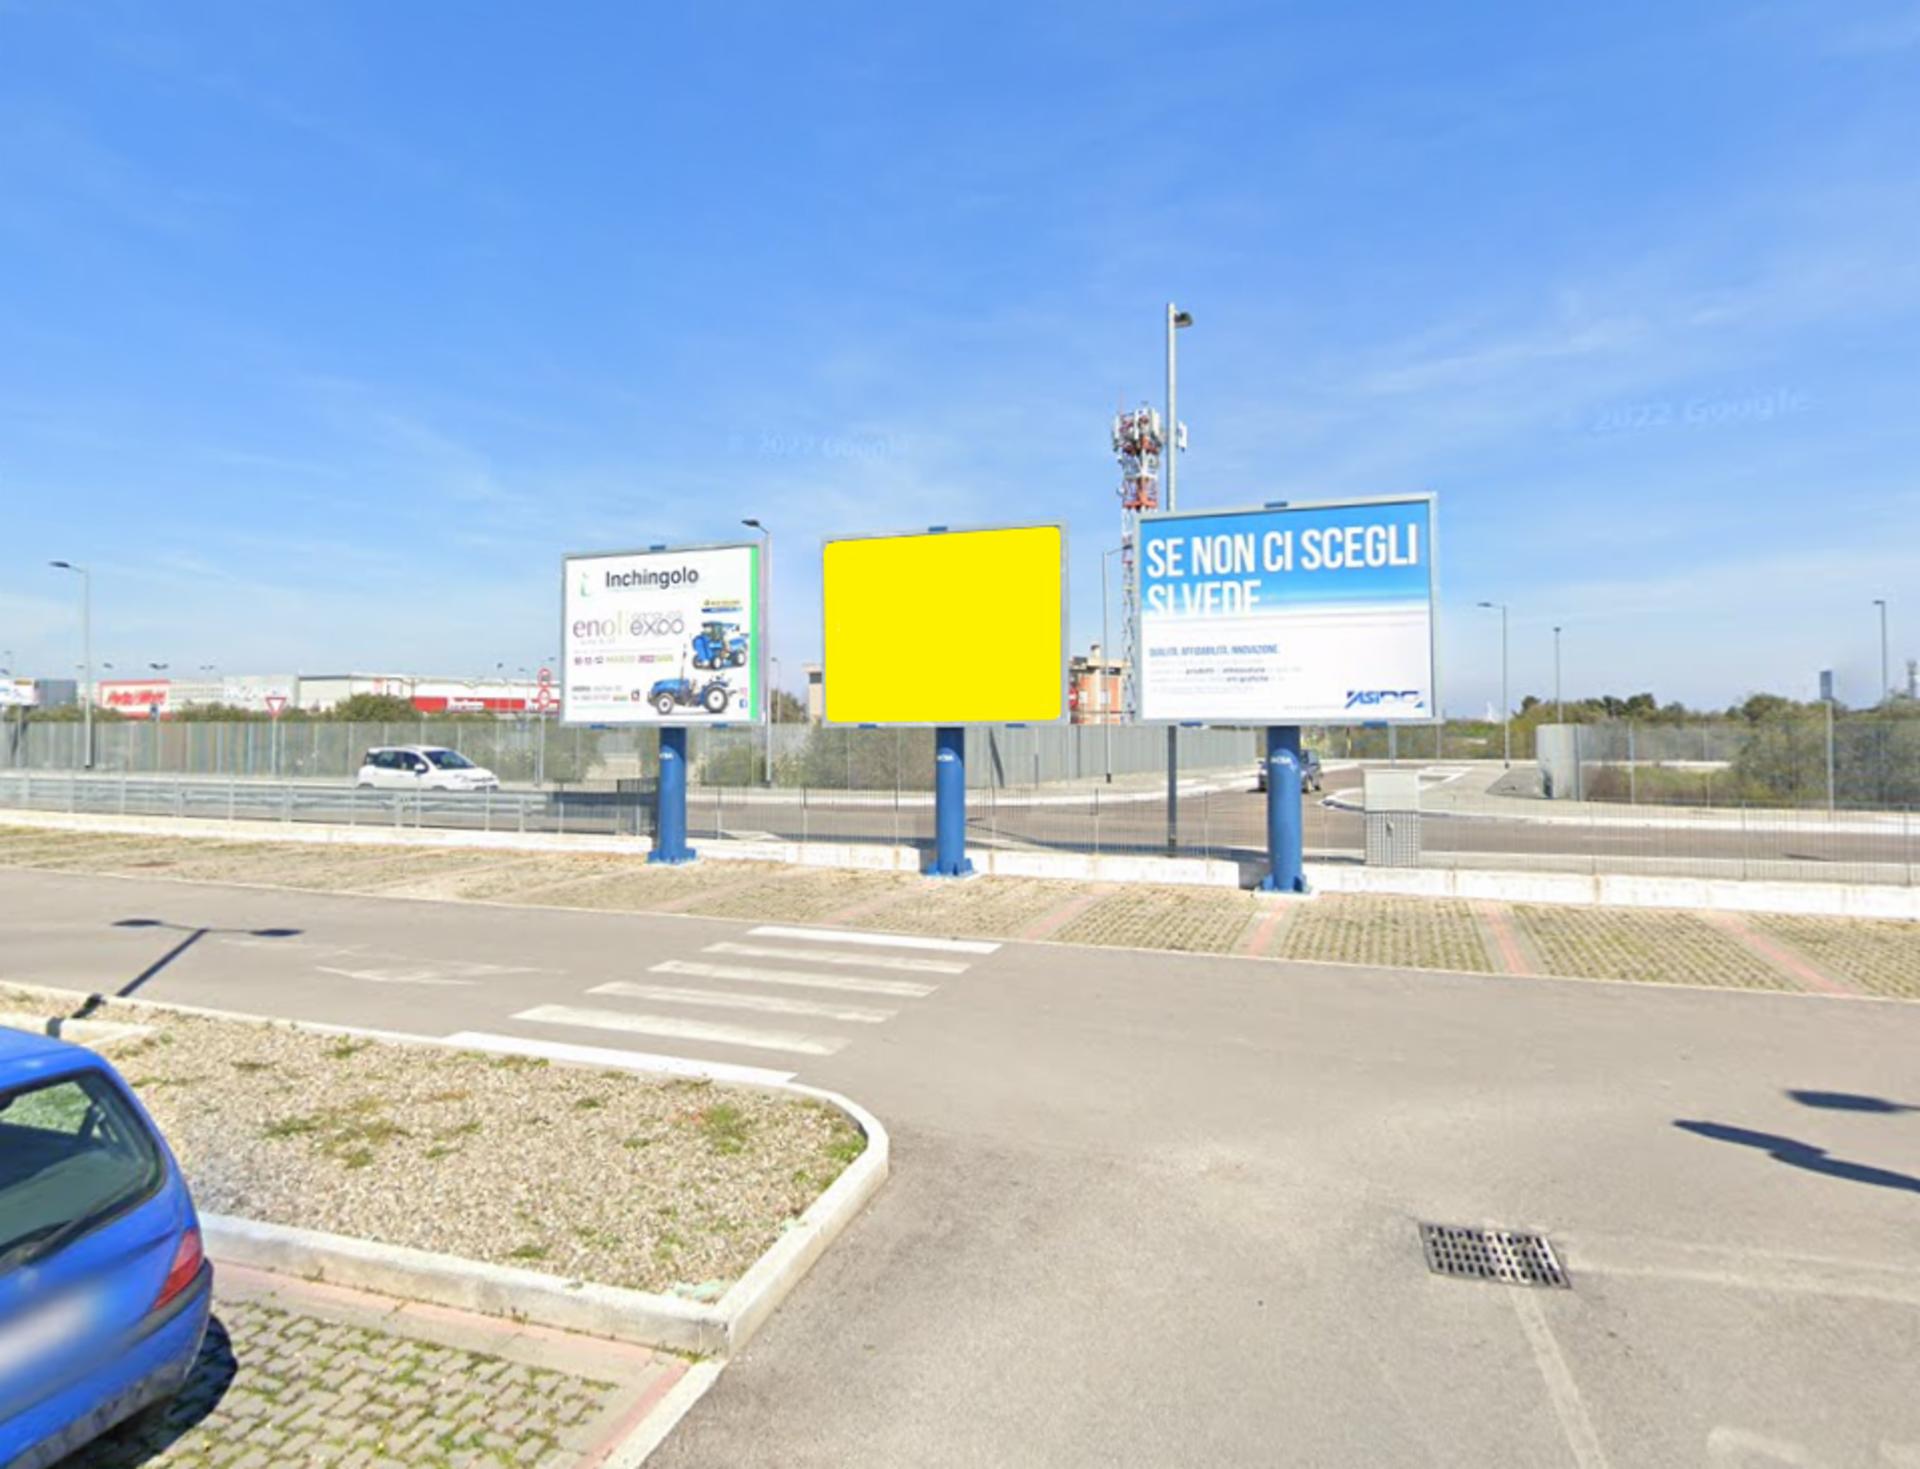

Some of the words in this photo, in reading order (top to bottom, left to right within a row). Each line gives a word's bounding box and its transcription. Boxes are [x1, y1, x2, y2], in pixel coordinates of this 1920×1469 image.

[1147, 538, 1184, 578] SE
[1192, 533, 1256, 576] NON
[1262, 530, 1293, 572] CI
[1300, 523, 1419, 570] SCEGLI
[605, 566, 699, 589] Inchingolo
